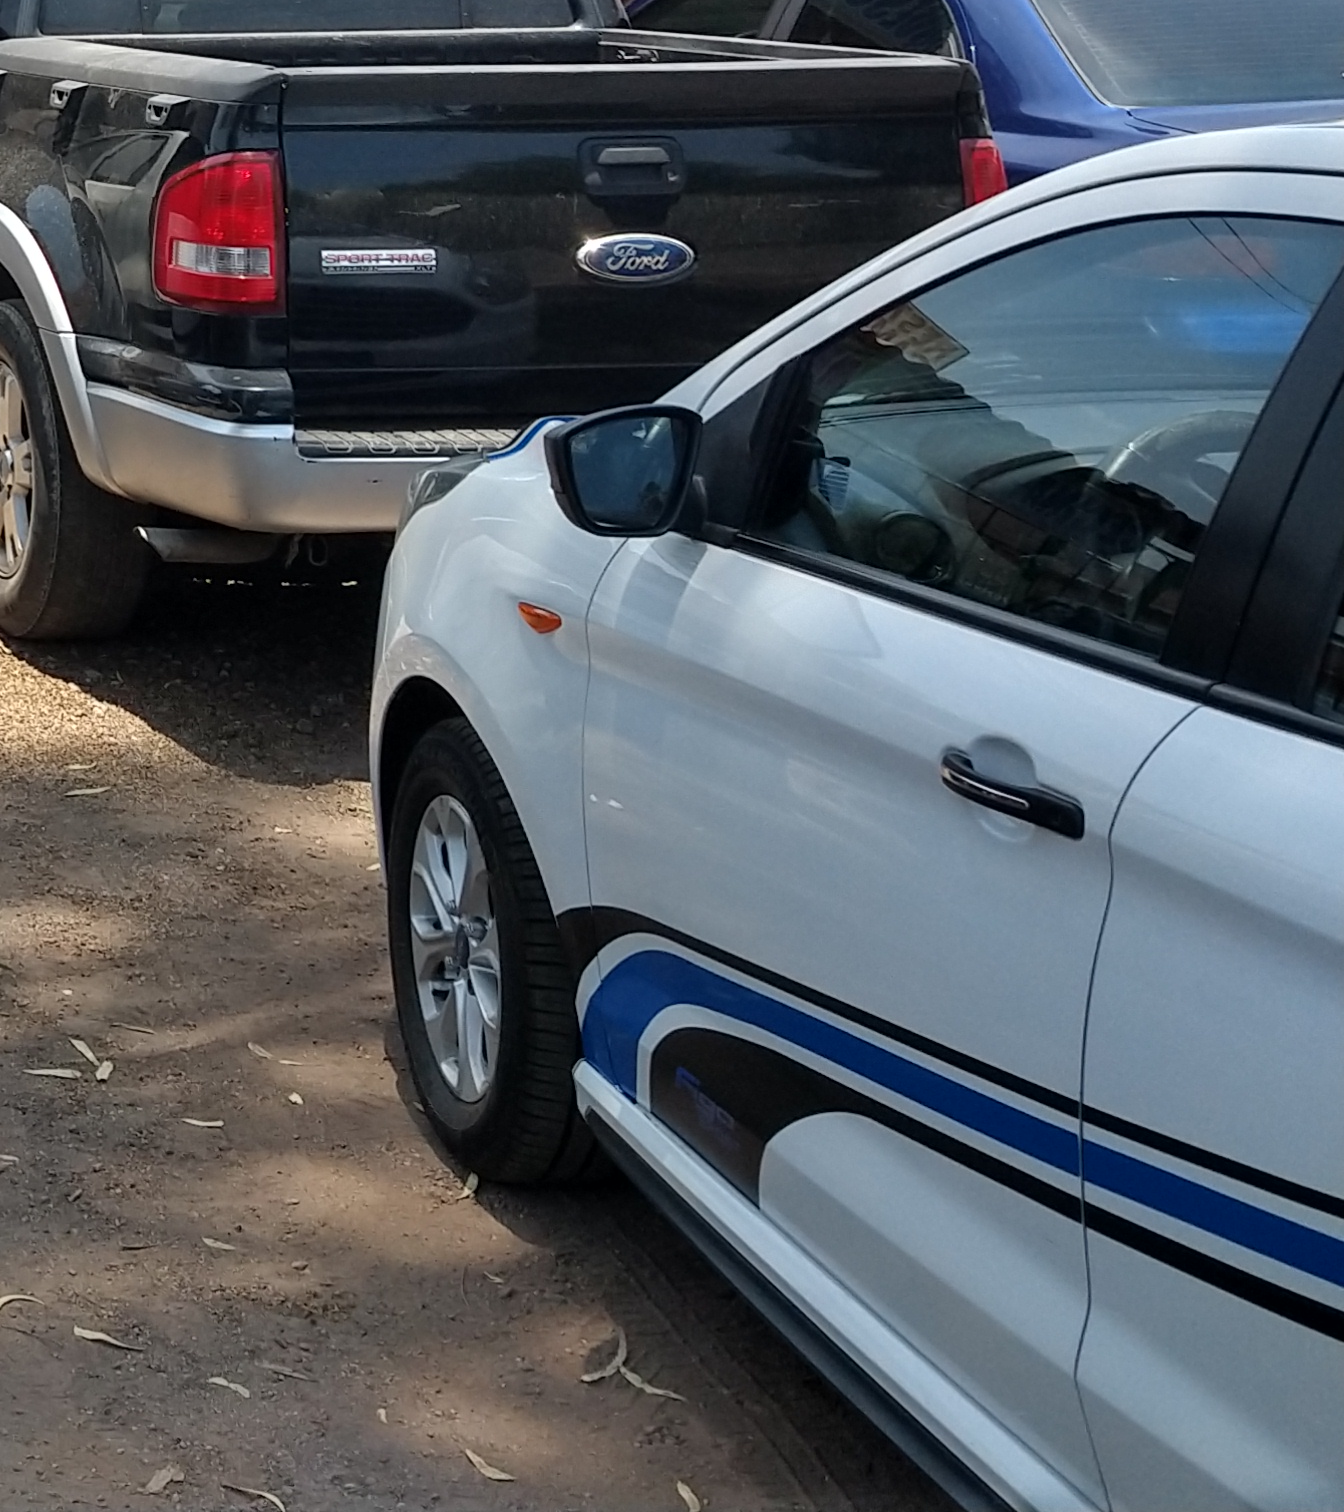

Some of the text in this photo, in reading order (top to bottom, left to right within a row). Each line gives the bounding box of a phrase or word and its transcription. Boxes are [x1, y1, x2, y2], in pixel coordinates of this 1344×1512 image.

[325, 254, 433, 263] SPORT TRAC
[607, 243, 670, 271] Ford
